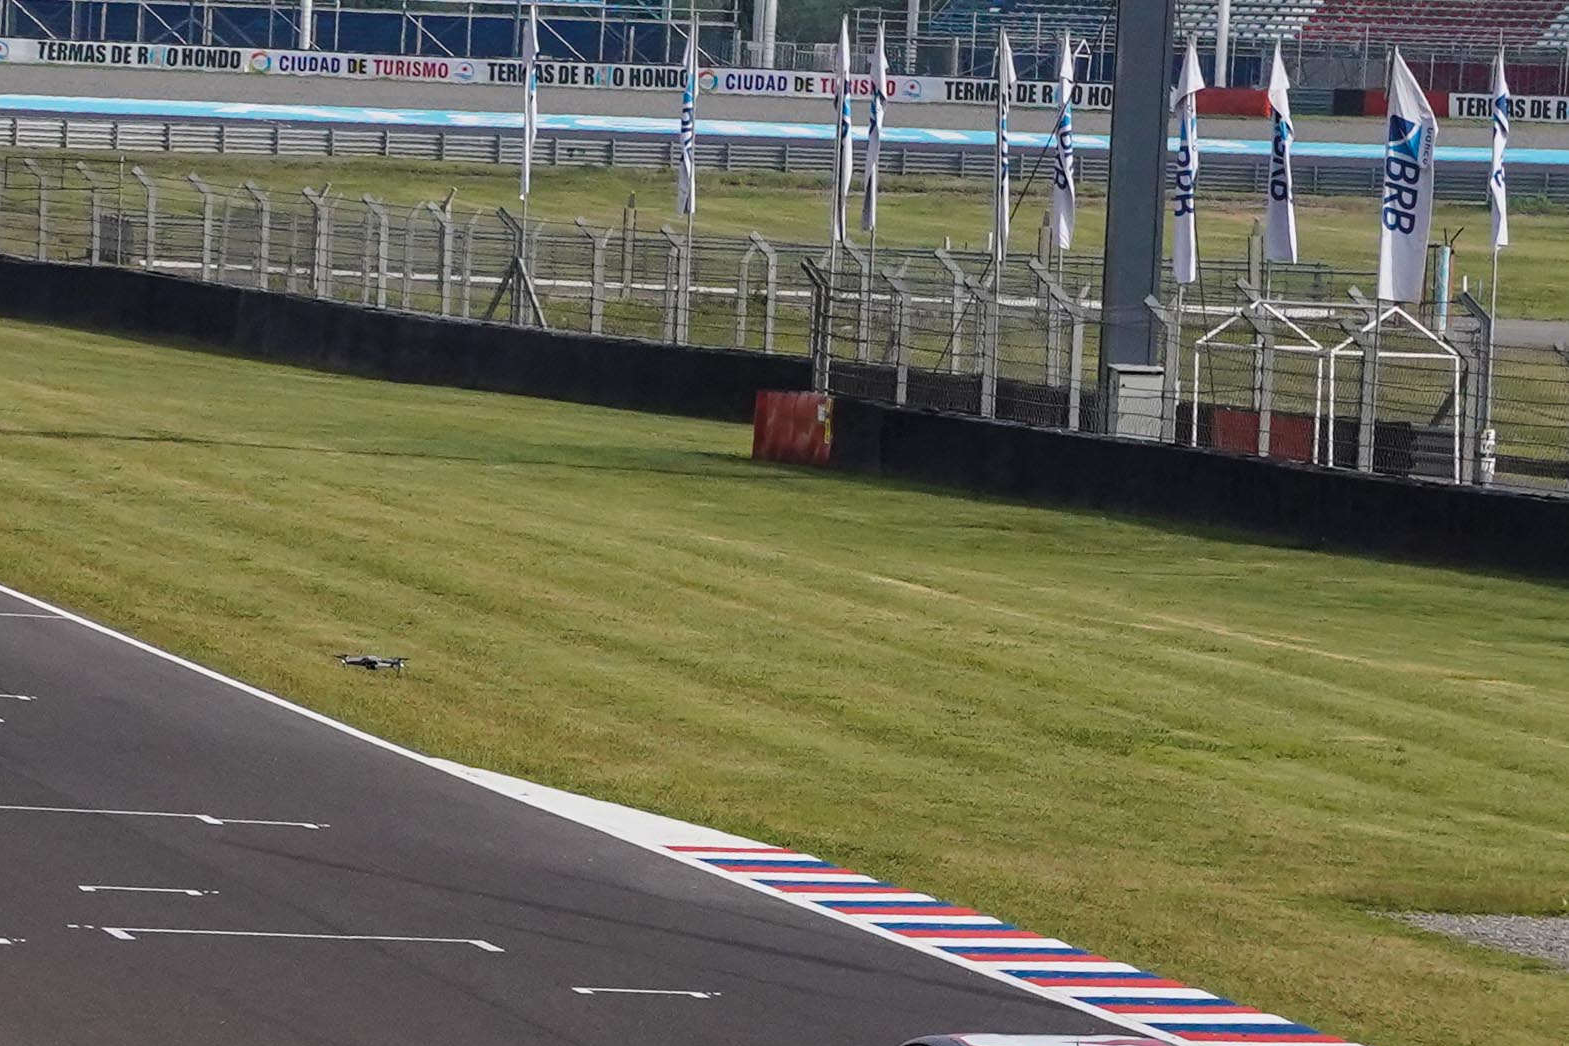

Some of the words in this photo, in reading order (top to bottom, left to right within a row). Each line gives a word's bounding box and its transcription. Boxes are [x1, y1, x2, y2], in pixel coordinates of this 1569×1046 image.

[38, 41, 108, 64] TERMAS
[111, 45, 132, 65] DE
[182, 48, 242, 69] HONDO
[280, 54, 341, 73] CIUDAD
[347, 58, 367, 75] DE
[373, 58, 449, 79] TURISMO
[558, 65, 579, 84] DE
[630, 67, 689, 89] HONDO
[725, 73, 787, 92] CIUDAD
[794, 76, 814, 93] DE
[1016, 83, 1037, 103] DE
[1530, 99, 1551, 119] DE
[1383, 155, 1421, 235] BRB
